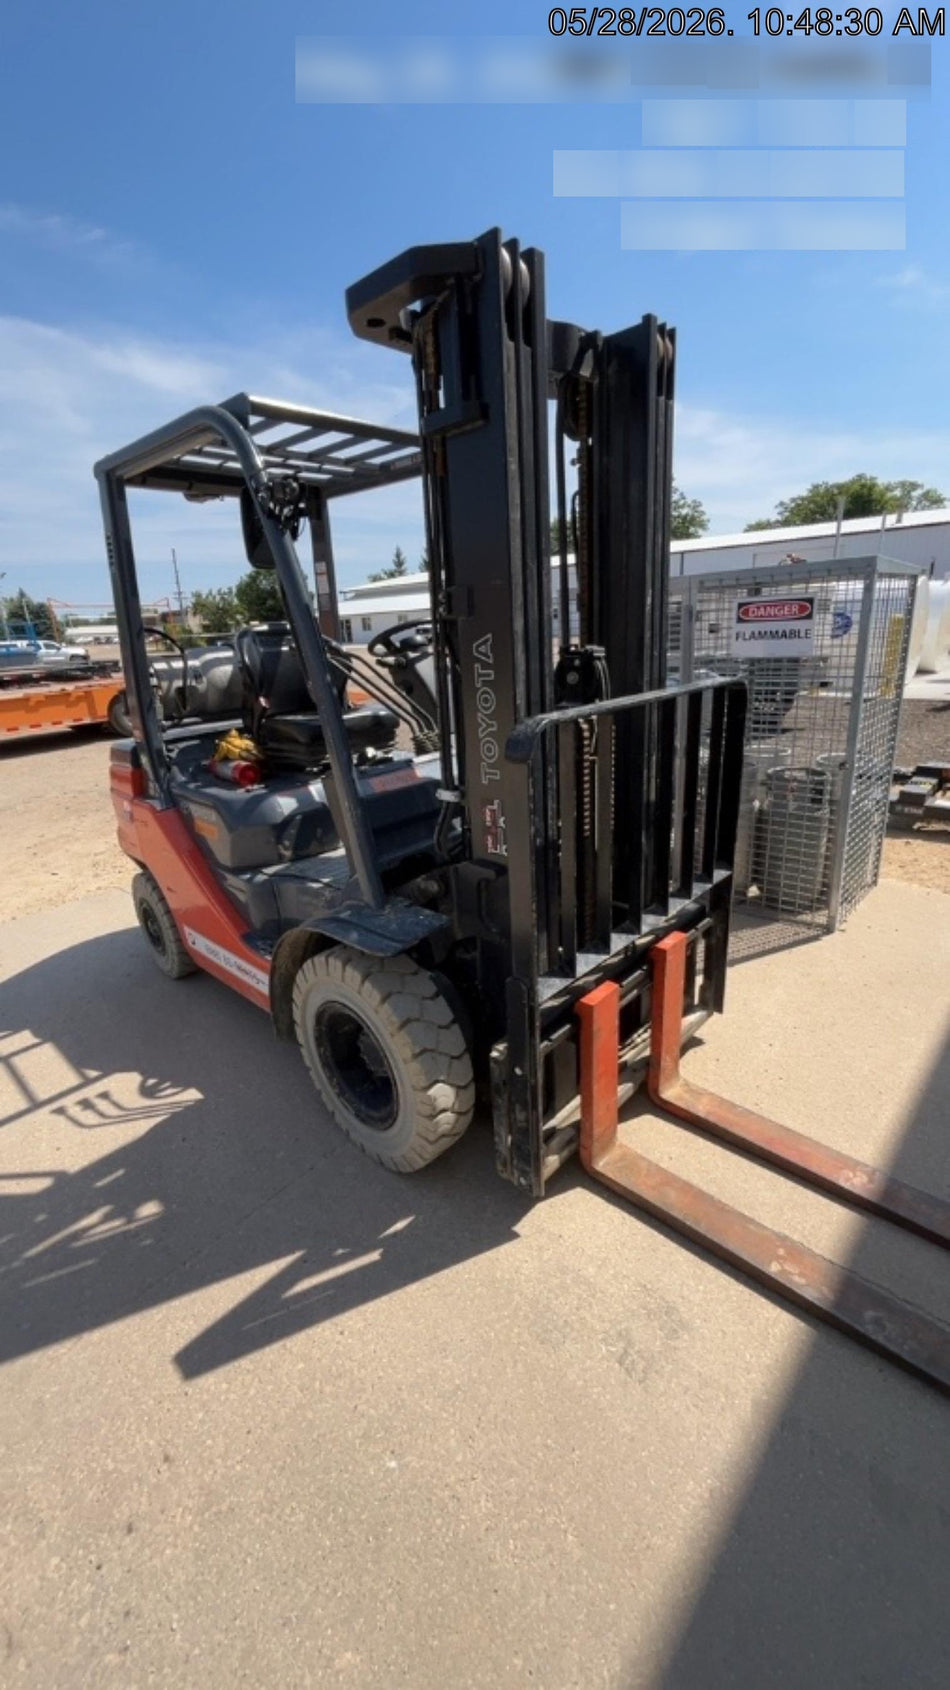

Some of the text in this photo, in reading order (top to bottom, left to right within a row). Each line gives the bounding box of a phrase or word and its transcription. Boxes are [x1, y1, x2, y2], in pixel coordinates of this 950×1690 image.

[748, 603, 799, 617] DANGER
[735, 628, 812, 642] FLAMMABLE
[473, 632, 500, 785] TOYOTA
